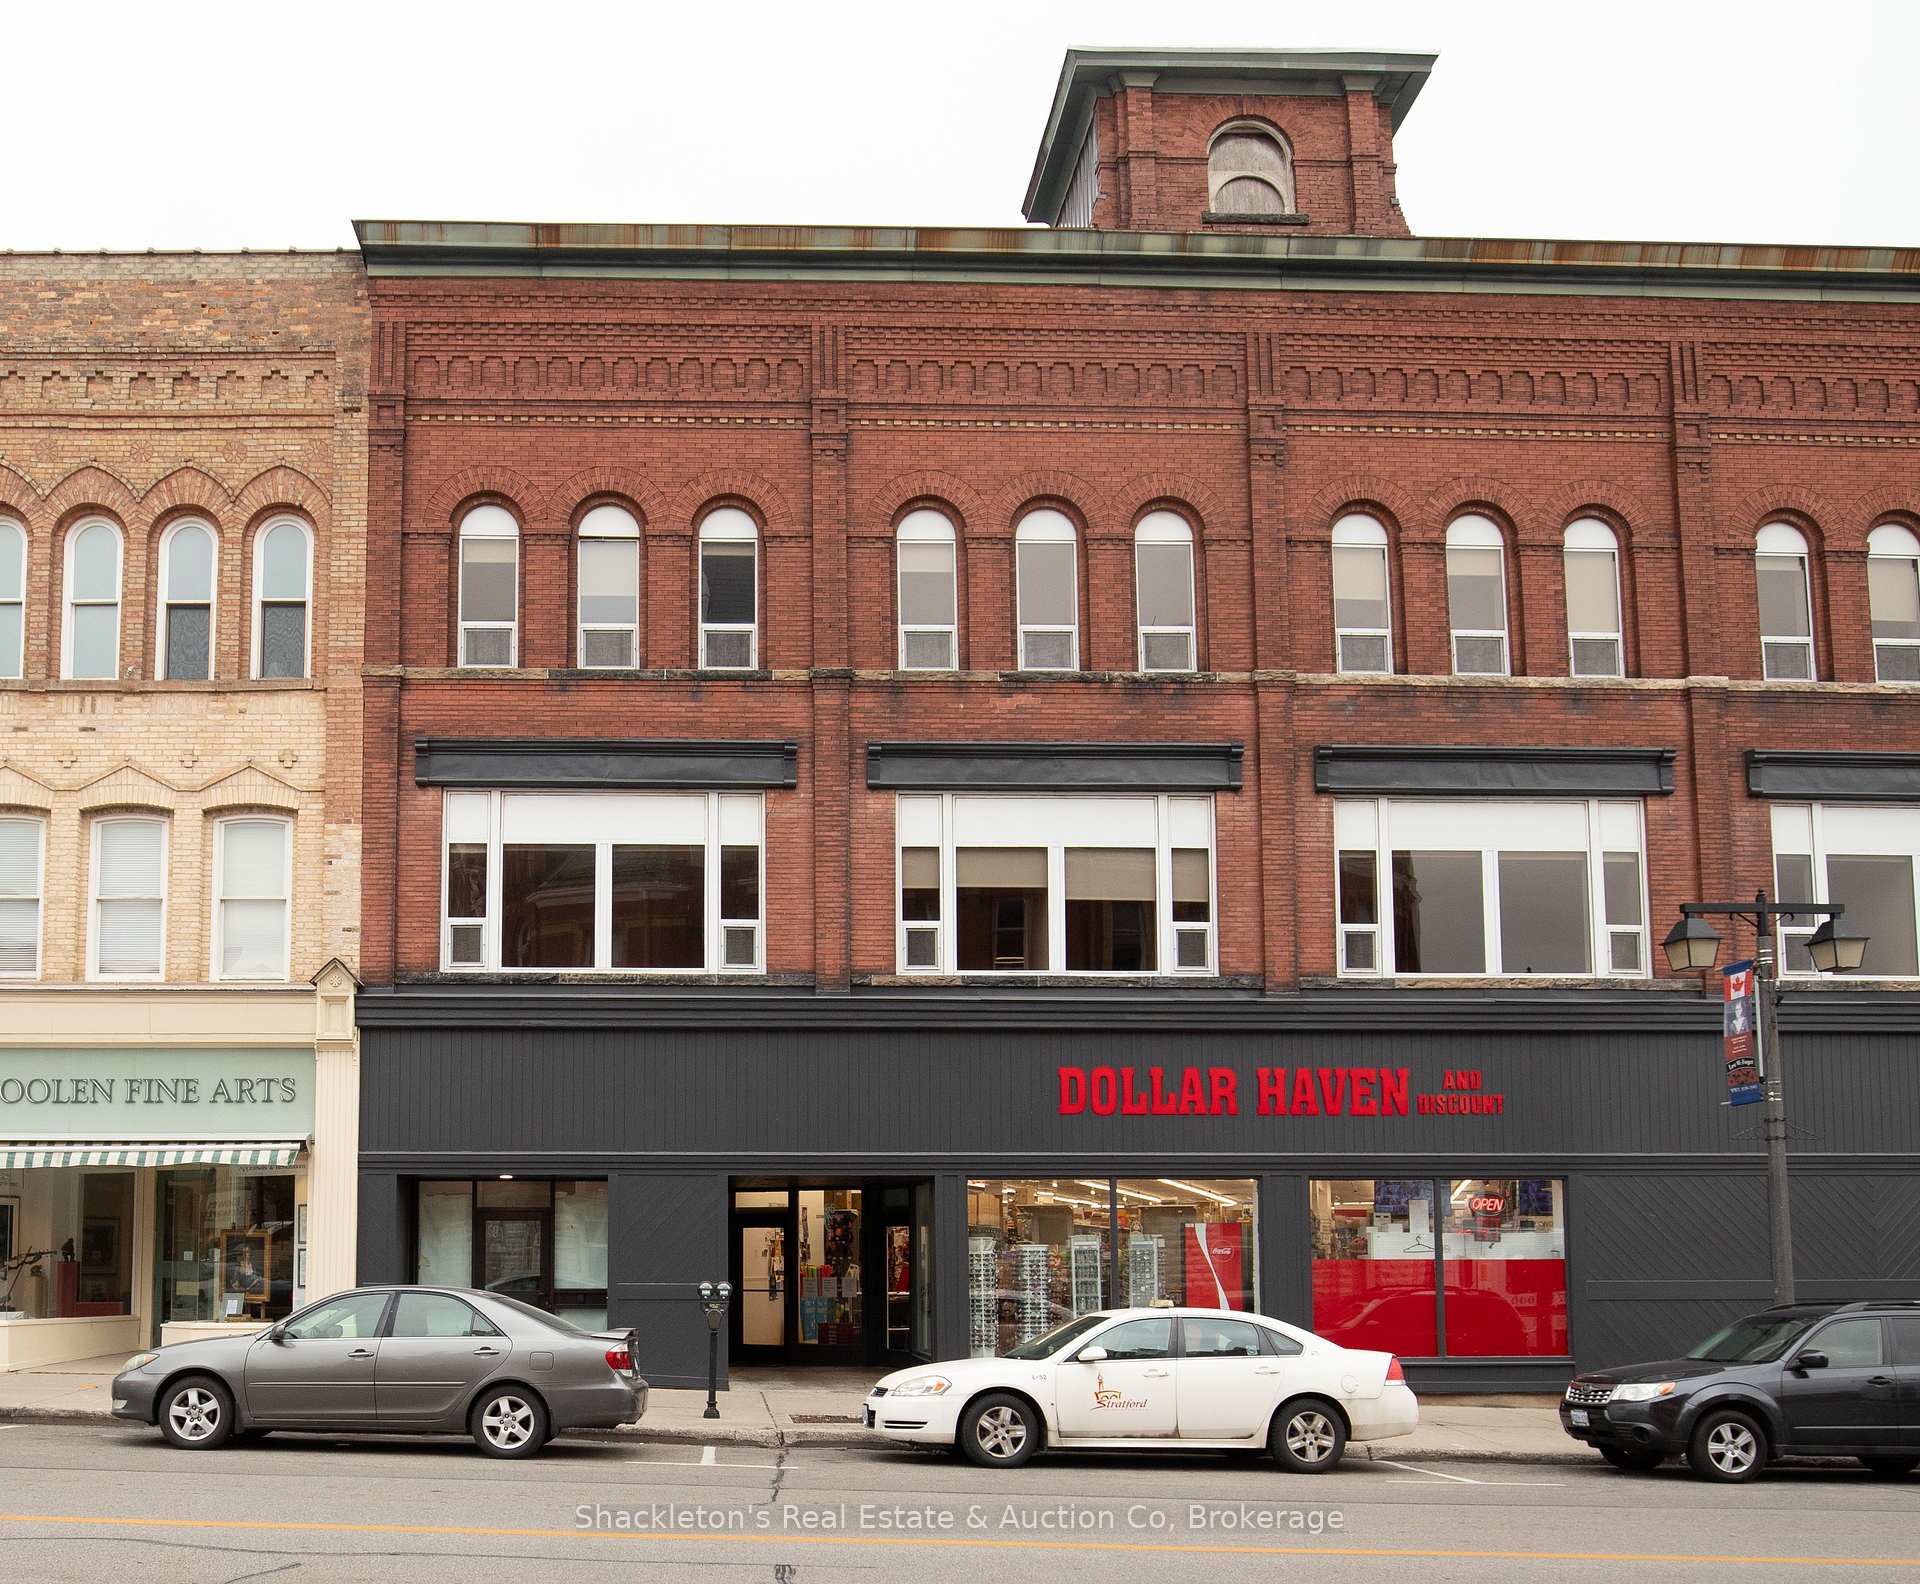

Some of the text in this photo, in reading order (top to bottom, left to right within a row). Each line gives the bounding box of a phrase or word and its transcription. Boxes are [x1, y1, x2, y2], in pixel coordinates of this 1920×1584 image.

[0, 1077, 296, 1104] OOLEN FINE ARTS
[1441, 1070, 1482, 1091] AND
[1057, 1066, 1410, 1117] DOLLAR HAVEN
[1416, 1094, 1505, 1116] DISCOUNT
[1471, 1198, 1504, 1211] OPEN
[1090, 1399, 1149, 1411] Stratford
